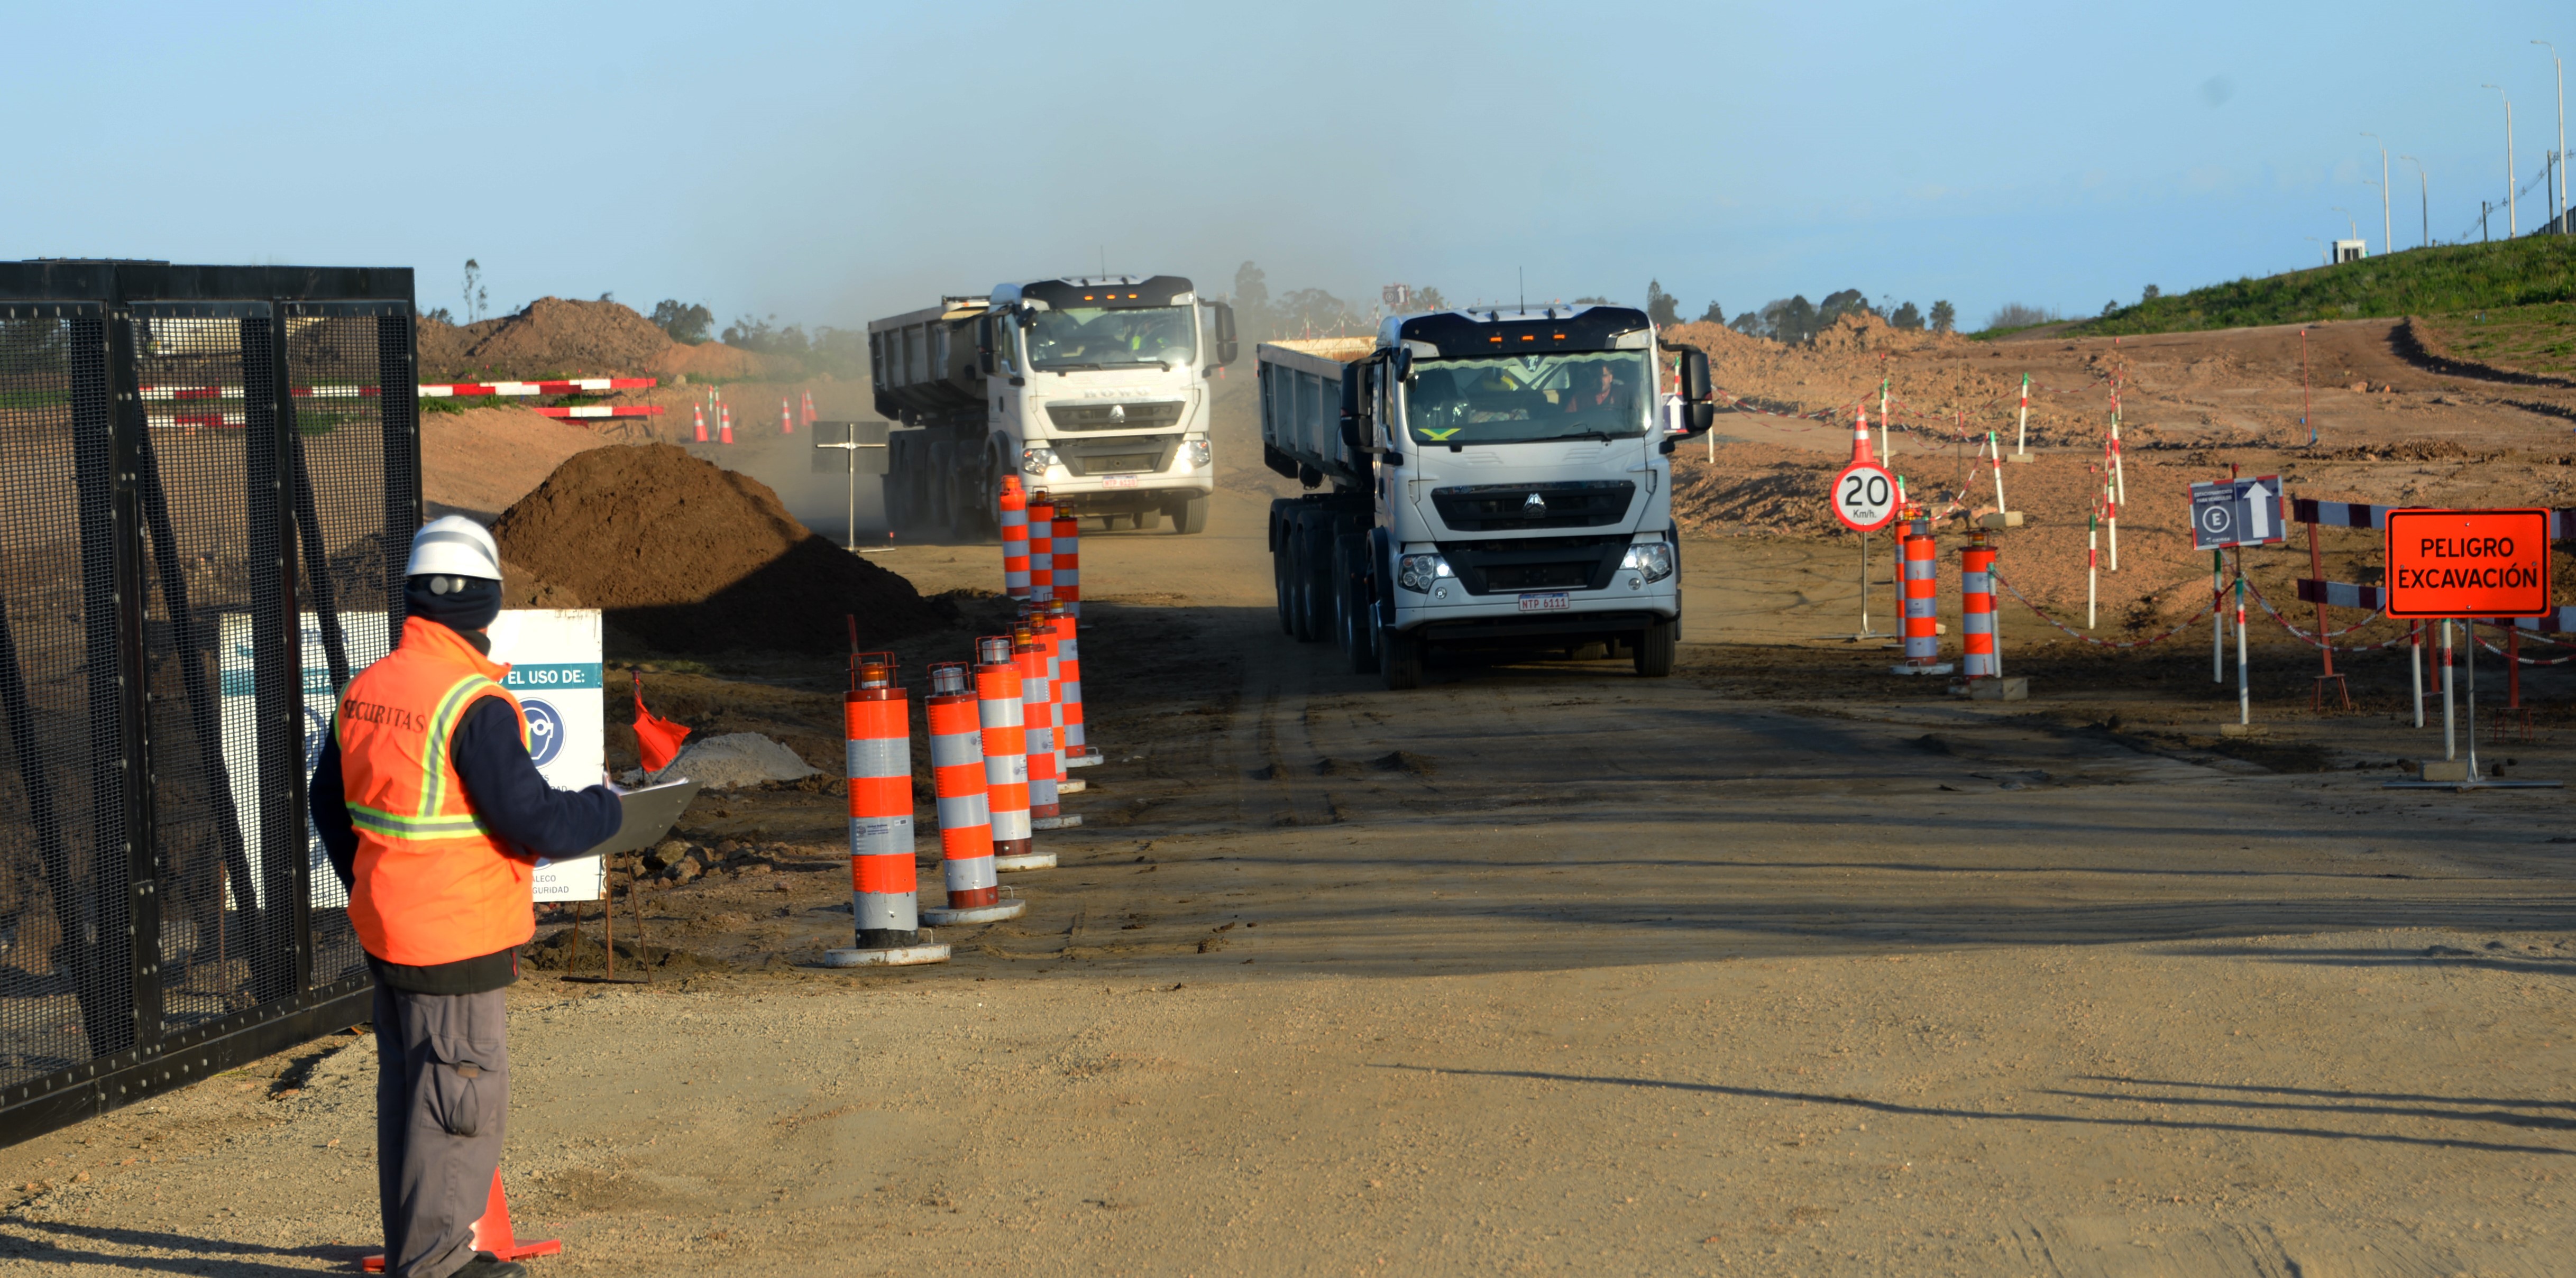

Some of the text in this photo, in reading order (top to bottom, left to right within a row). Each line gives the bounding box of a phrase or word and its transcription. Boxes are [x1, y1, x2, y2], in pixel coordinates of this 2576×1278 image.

[1845, 475, 1889, 507] 20
[1853, 509, 1877, 518] Km/h.
[2212, 513, 2221, 526] E
[2421, 537, 2514, 558] PELIGRO
[2398, 563, 2537, 589] EXCAVACIÓN
[1522, 597, 1566, 609] NTP 6111
[508, 671, 525, 685] EL
[529, 670, 558, 684] USO
[562, 669, 585, 684] DE:
[344, 699, 426, 734] SECURITAS
